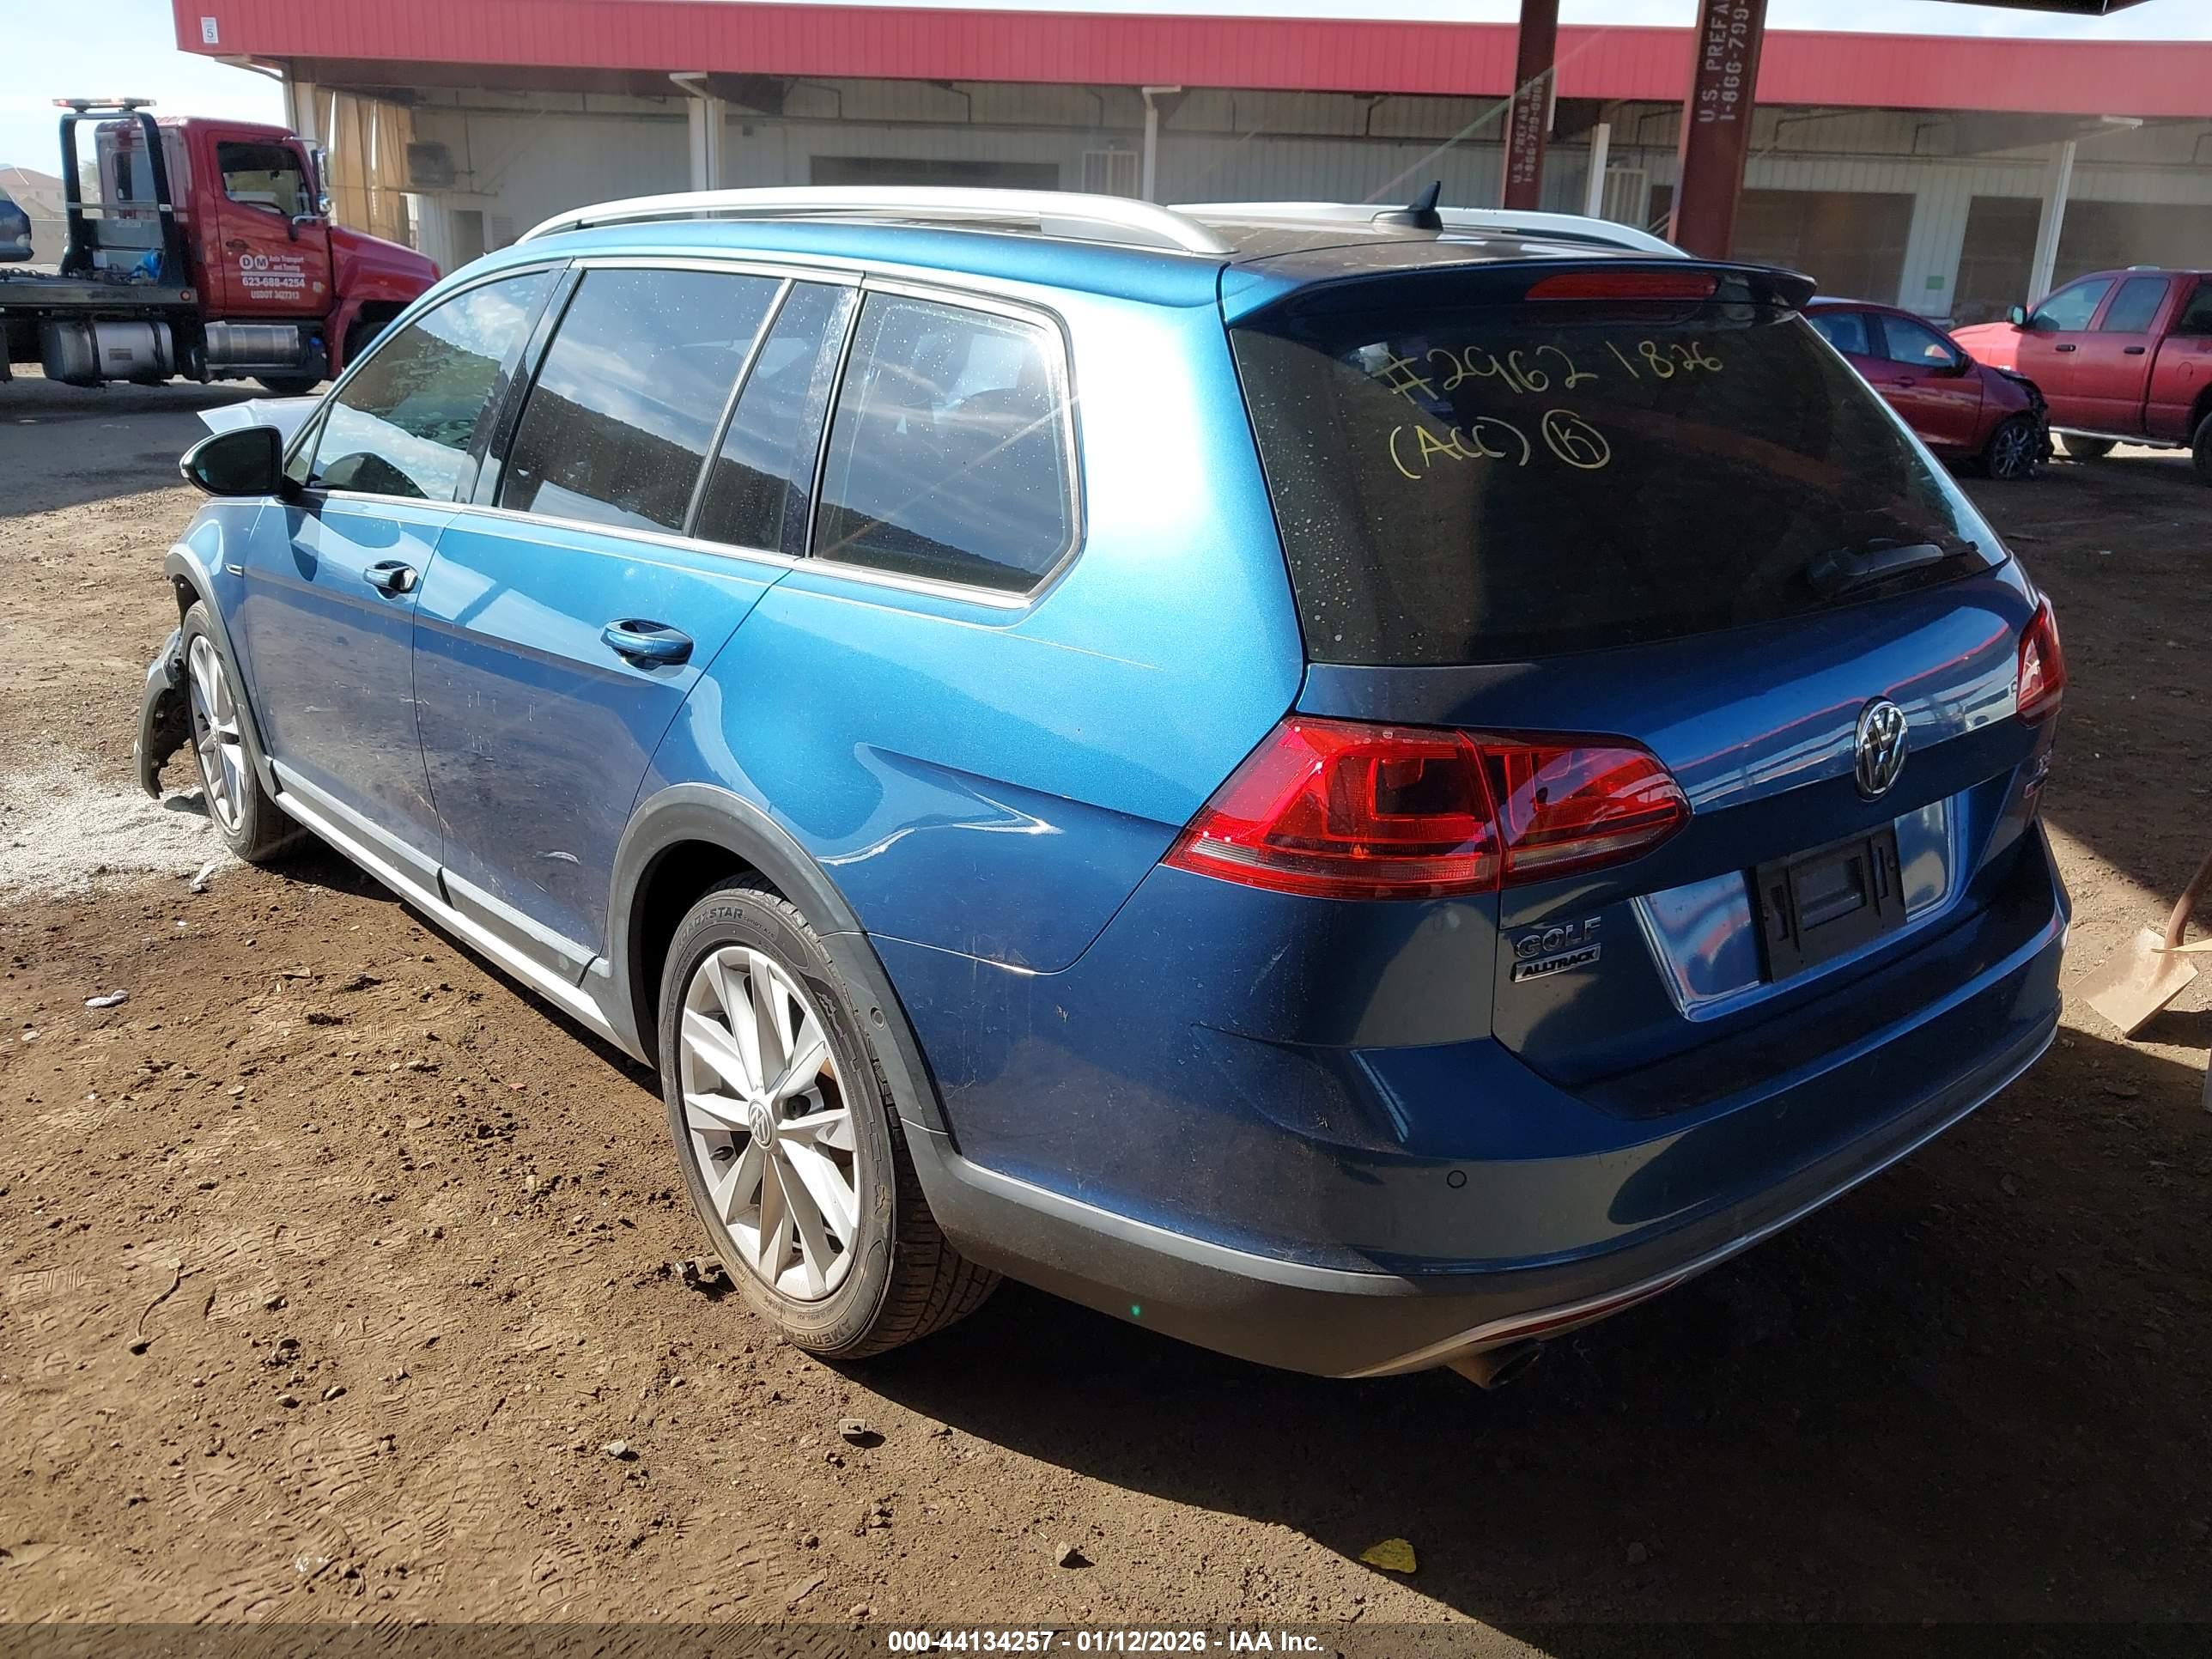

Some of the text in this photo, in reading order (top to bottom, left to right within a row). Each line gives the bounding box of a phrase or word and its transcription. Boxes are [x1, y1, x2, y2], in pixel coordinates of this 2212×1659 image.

[206, 27, 214, 39] 5
[242, 276, 306, 288] 623-688-4254
[251, 290, 273, 299] USDOT
[1516, 915, 1601, 959] GOLF
